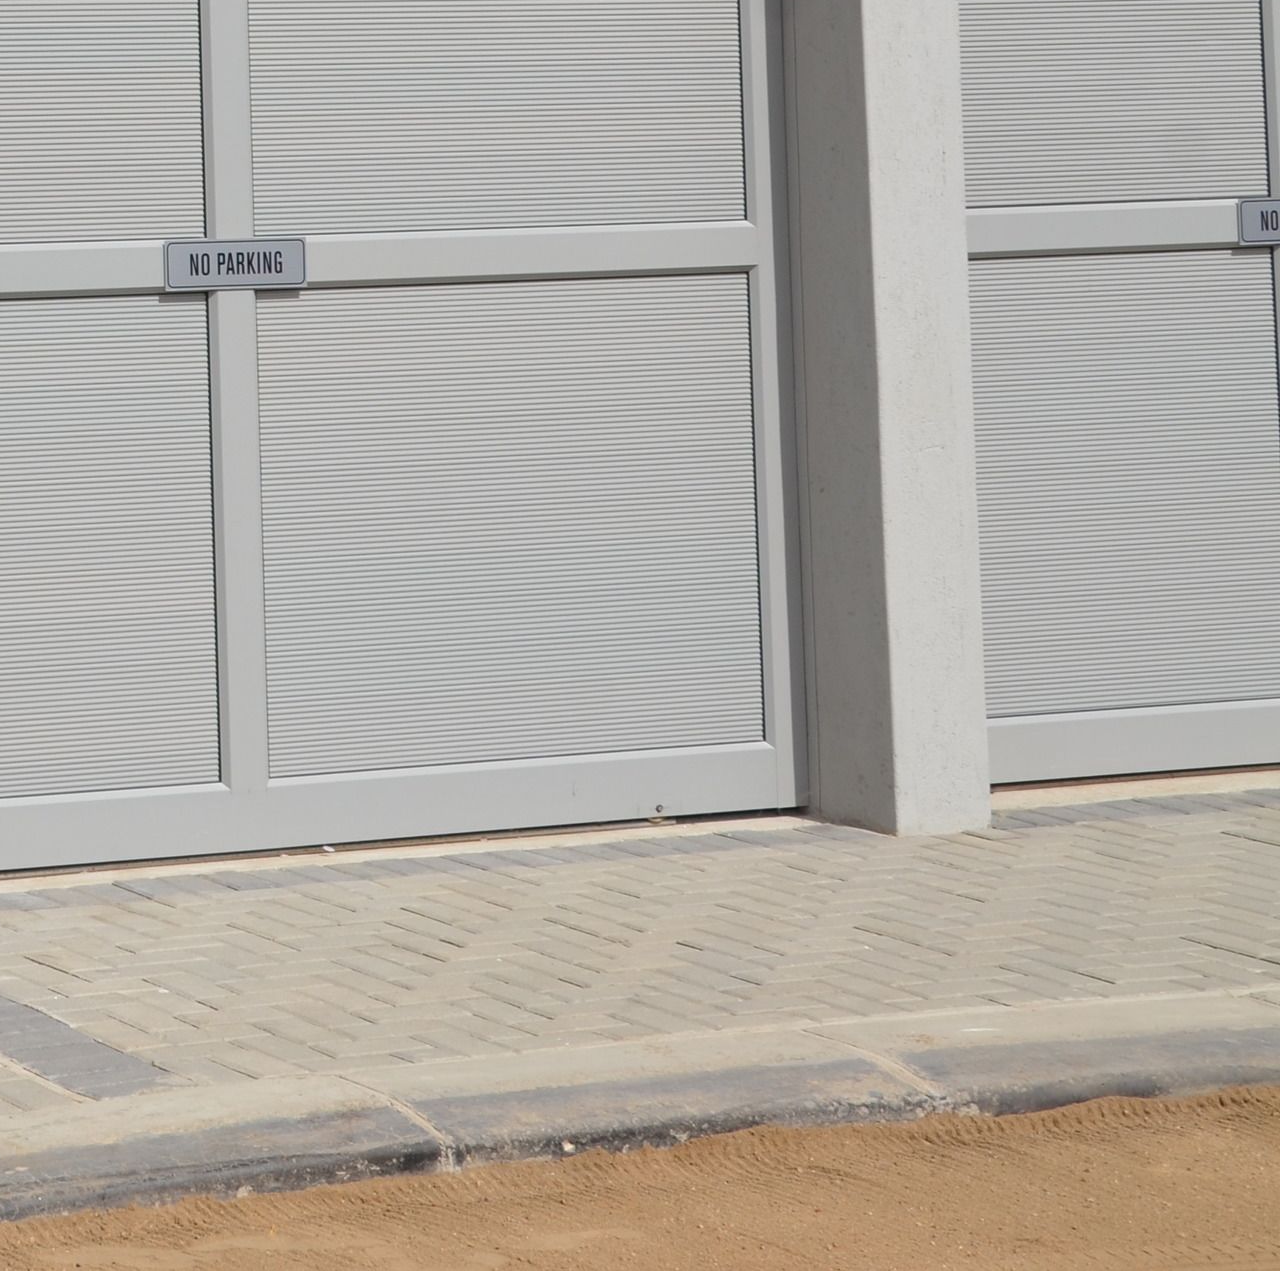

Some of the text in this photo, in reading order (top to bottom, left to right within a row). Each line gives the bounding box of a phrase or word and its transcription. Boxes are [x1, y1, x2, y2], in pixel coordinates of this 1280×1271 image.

[1260, 209, 1280, 232] NO
[189, 250, 284, 277] NO PARKING
